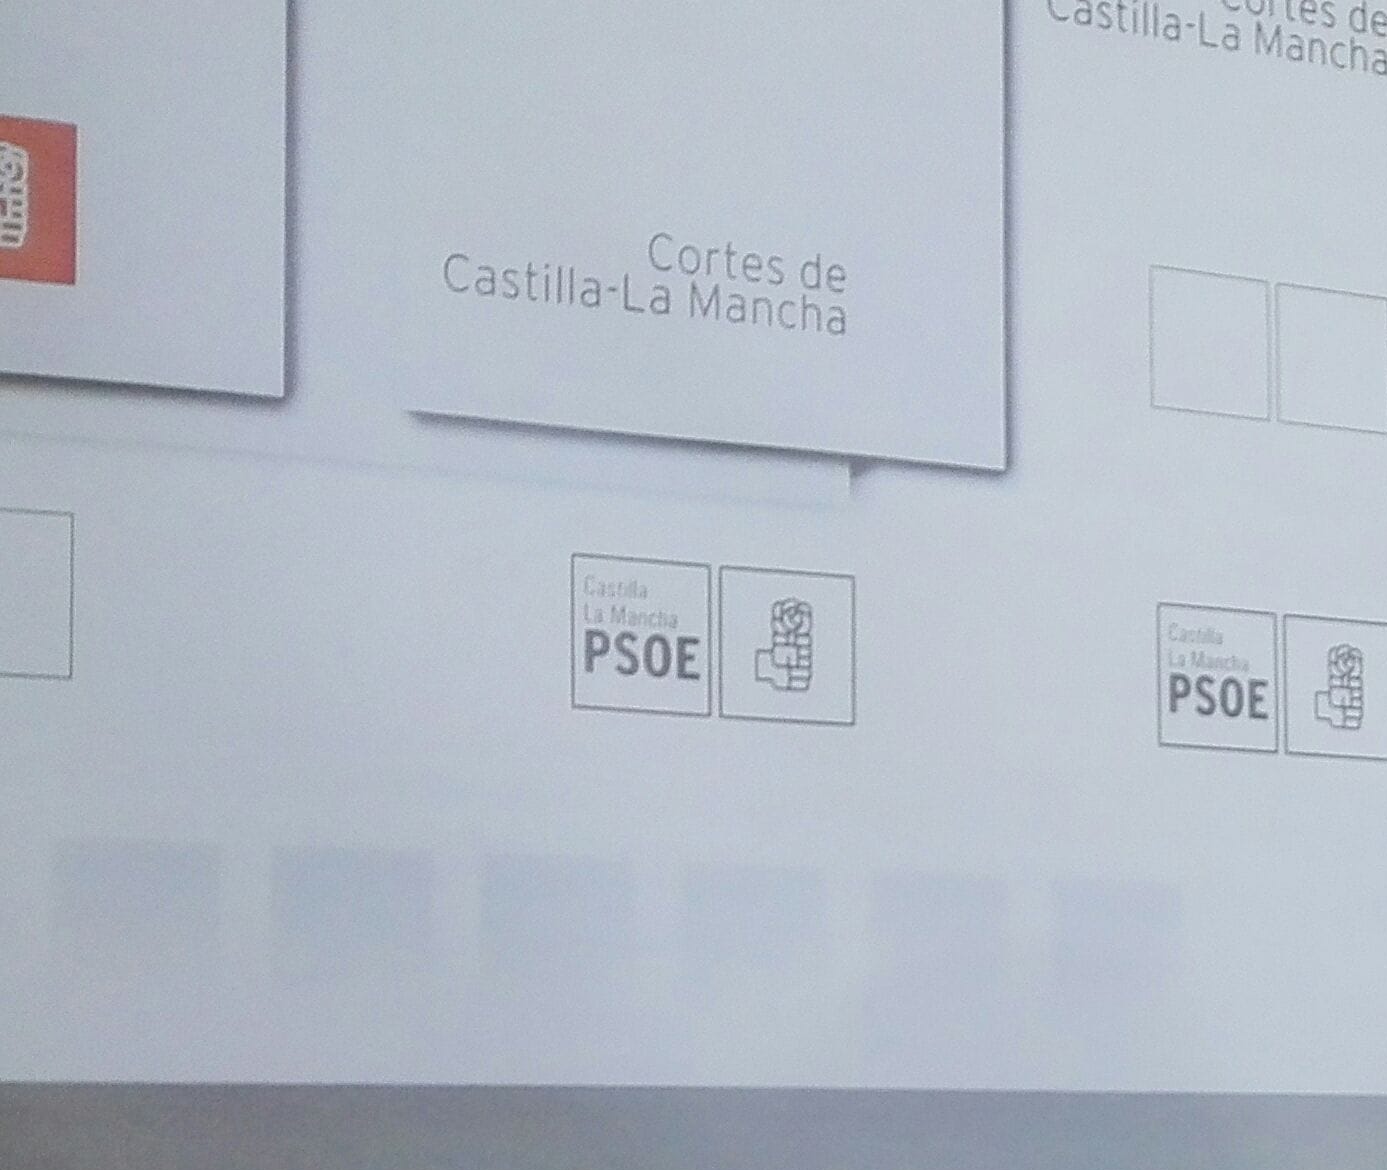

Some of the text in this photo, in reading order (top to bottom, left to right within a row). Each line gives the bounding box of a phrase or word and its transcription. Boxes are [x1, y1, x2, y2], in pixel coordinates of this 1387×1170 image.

[1049, 0, 1240, 50] Castilla-La
[648, 232, 847, 292] Cortes de
[443, 253, 847, 335] Castilla-La Mancha
[584, 628, 700, 680] PSOE
[1169, 673, 1268, 719] PSOE
